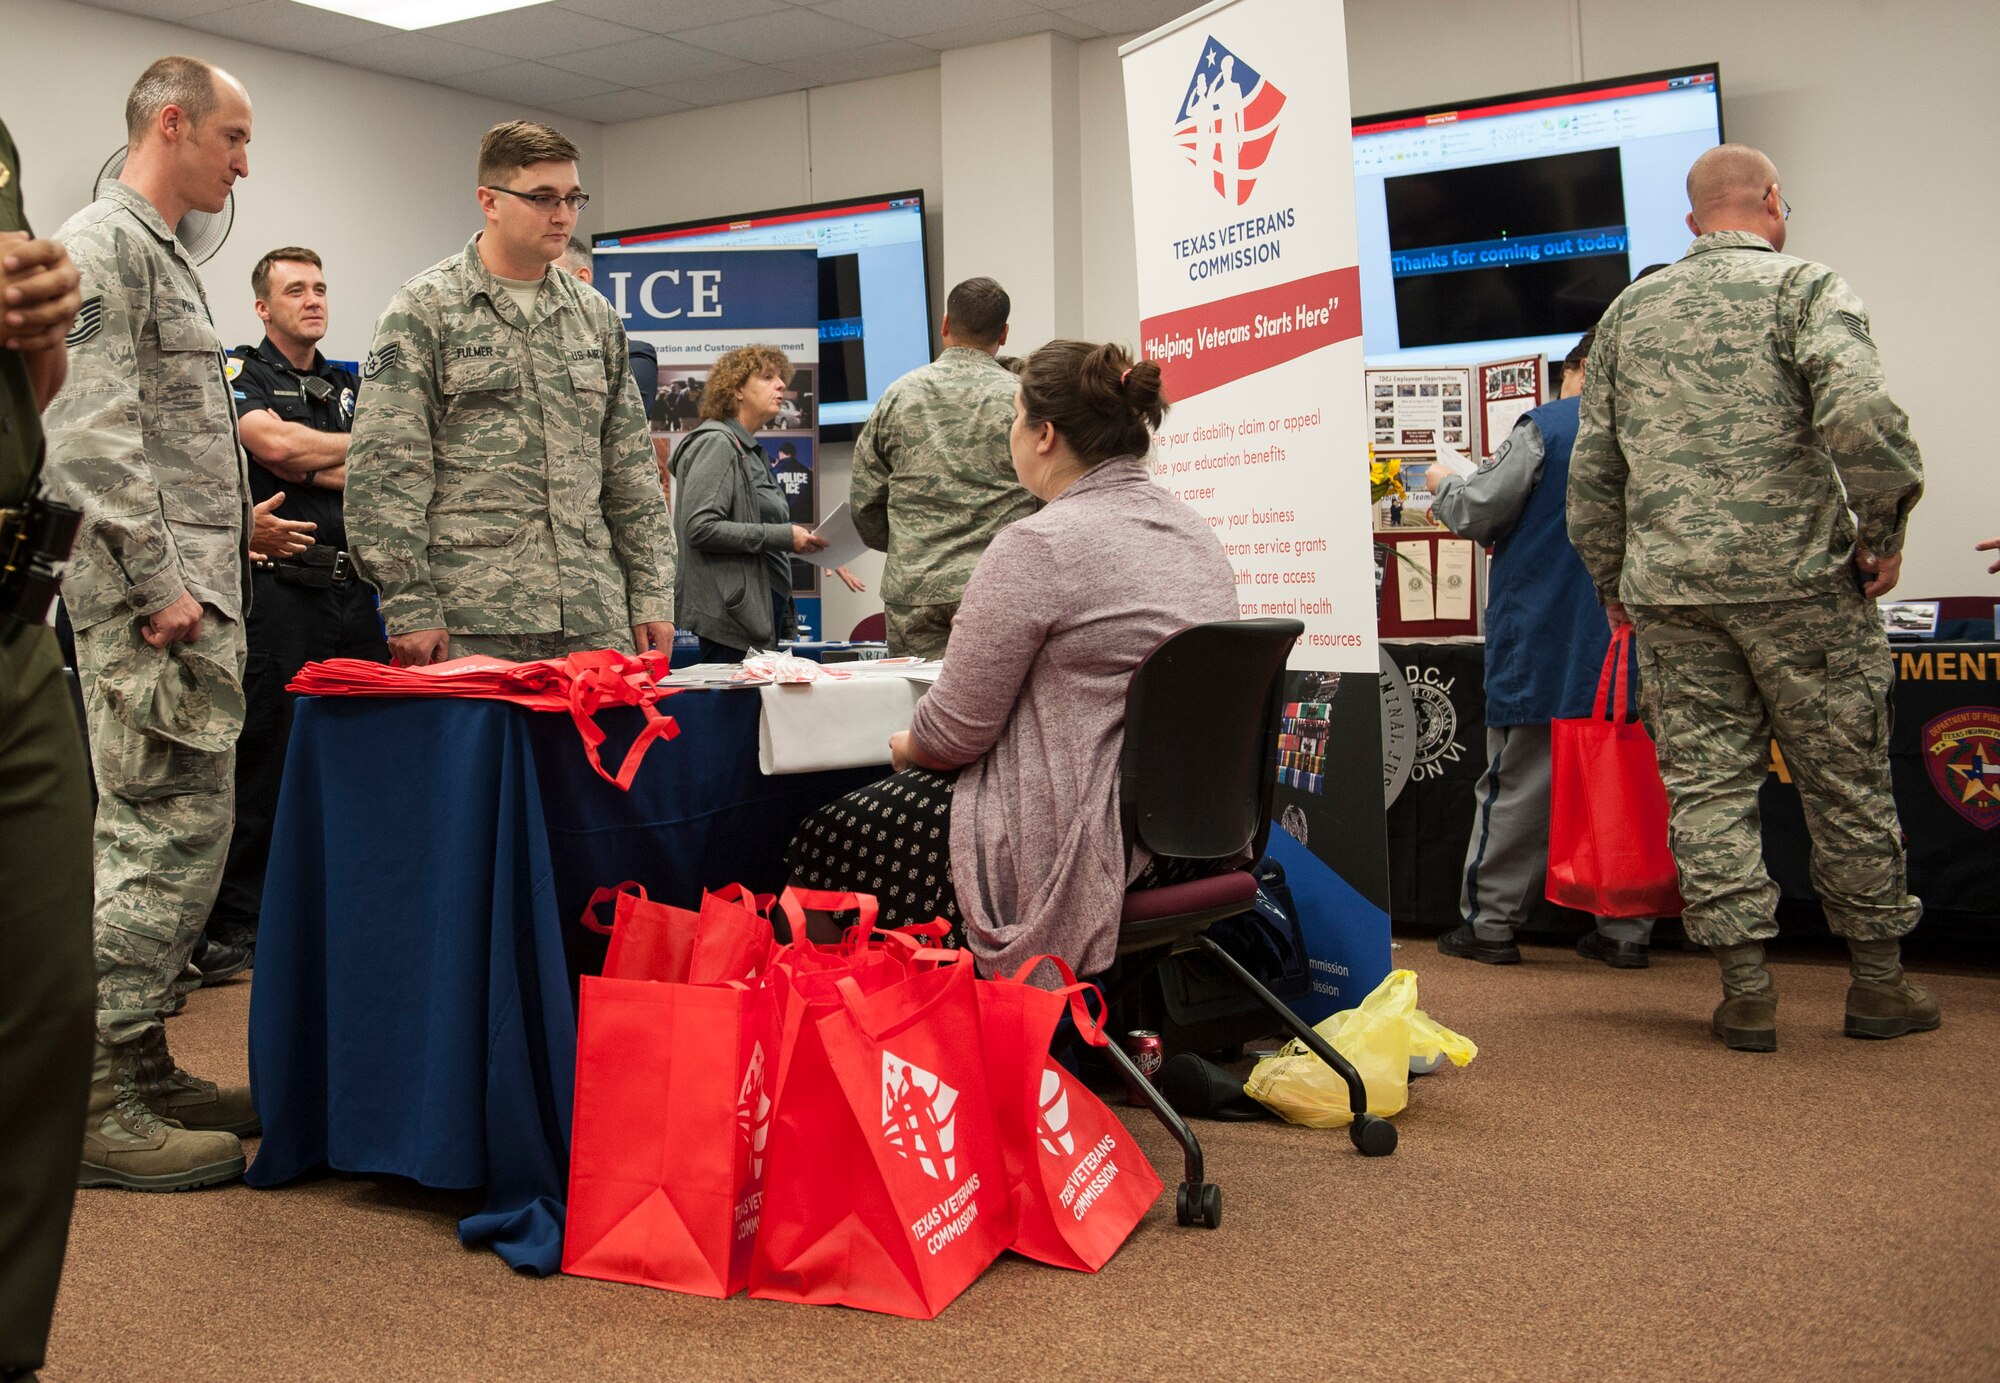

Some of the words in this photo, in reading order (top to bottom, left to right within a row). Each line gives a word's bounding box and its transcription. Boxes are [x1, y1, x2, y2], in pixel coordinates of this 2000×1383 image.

[1173, 231, 1216, 260] TEXAS
[1218, 207, 1295, 246] VETERANS
[1189, 240, 1281, 281] COMMISSION
[1392, 253, 1449, 272] Thanks
[1452, 250, 1475, 265] for
[1480, 243, 1540, 262] coming
[1544, 240, 1573, 256] out
[1577, 233, 1626, 251] today
[608, 269, 723, 319] ICE
[830, 323, 862, 338] today
[1197, 323, 1250, 351] Veterans
[1254, 312, 1292, 339] Starts
[456, 346, 493, 359] FULMER
[654, 345, 683, 353] ration
[685, 344, 701, 352] and
[1393, 375, 1423, 384] Employment
[1169, 432, 1190, 449] your
[1193, 422, 1235, 442] disability
[1239, 418, 1265, 436] claim
[1269, 419, 1281, 431] or
[1284, 407, 1321, 433] appeal
[1153, 460, 1168, 476] Use
[1171, 460, 1192, 478] your
[1194, 451, 1241, 471] education
[1243, 445, 1286, 465] benefits
[776, 471, 808, 484] POLICE
[785, 483, 800, 494] ICE
[1183, 487, 1216, 500] career
[1228, 513, 1249, 530] your
[1252, 507, 1295, 524] business
[1225, 542, 1251, 556] teran
[1254, 538, 1291, 554] service
[1294, 537, 1327, 557] grants
[1234, 568, 1252, 585] alth
[1255, 572, 1279, 585] care
[1283, 571, 1316, 584] access
[1239, 603, 1258, 615] rans
[1261, 597, 1297, 615] mental
[1300, 597, 1333, 615] health
[1308, 633, 1362, 647] resources
[1929, 713, 1970, 738] DEPARTMENT
[1971, 712, 1981, 721] OF
[1943, 729, 1965, 740] TEXAS
[1965, 726, 1993, 738] HIGHWAY
[1309, 958, 1349, 977] mmission
[1140, 1052, 1153, 1063] Dr
[1068, 1134, 1116, 1188] VETERANS
[911, 1207, 941, 1241] TEXAS
[938, 1173, 980, 1218] VETERANS
